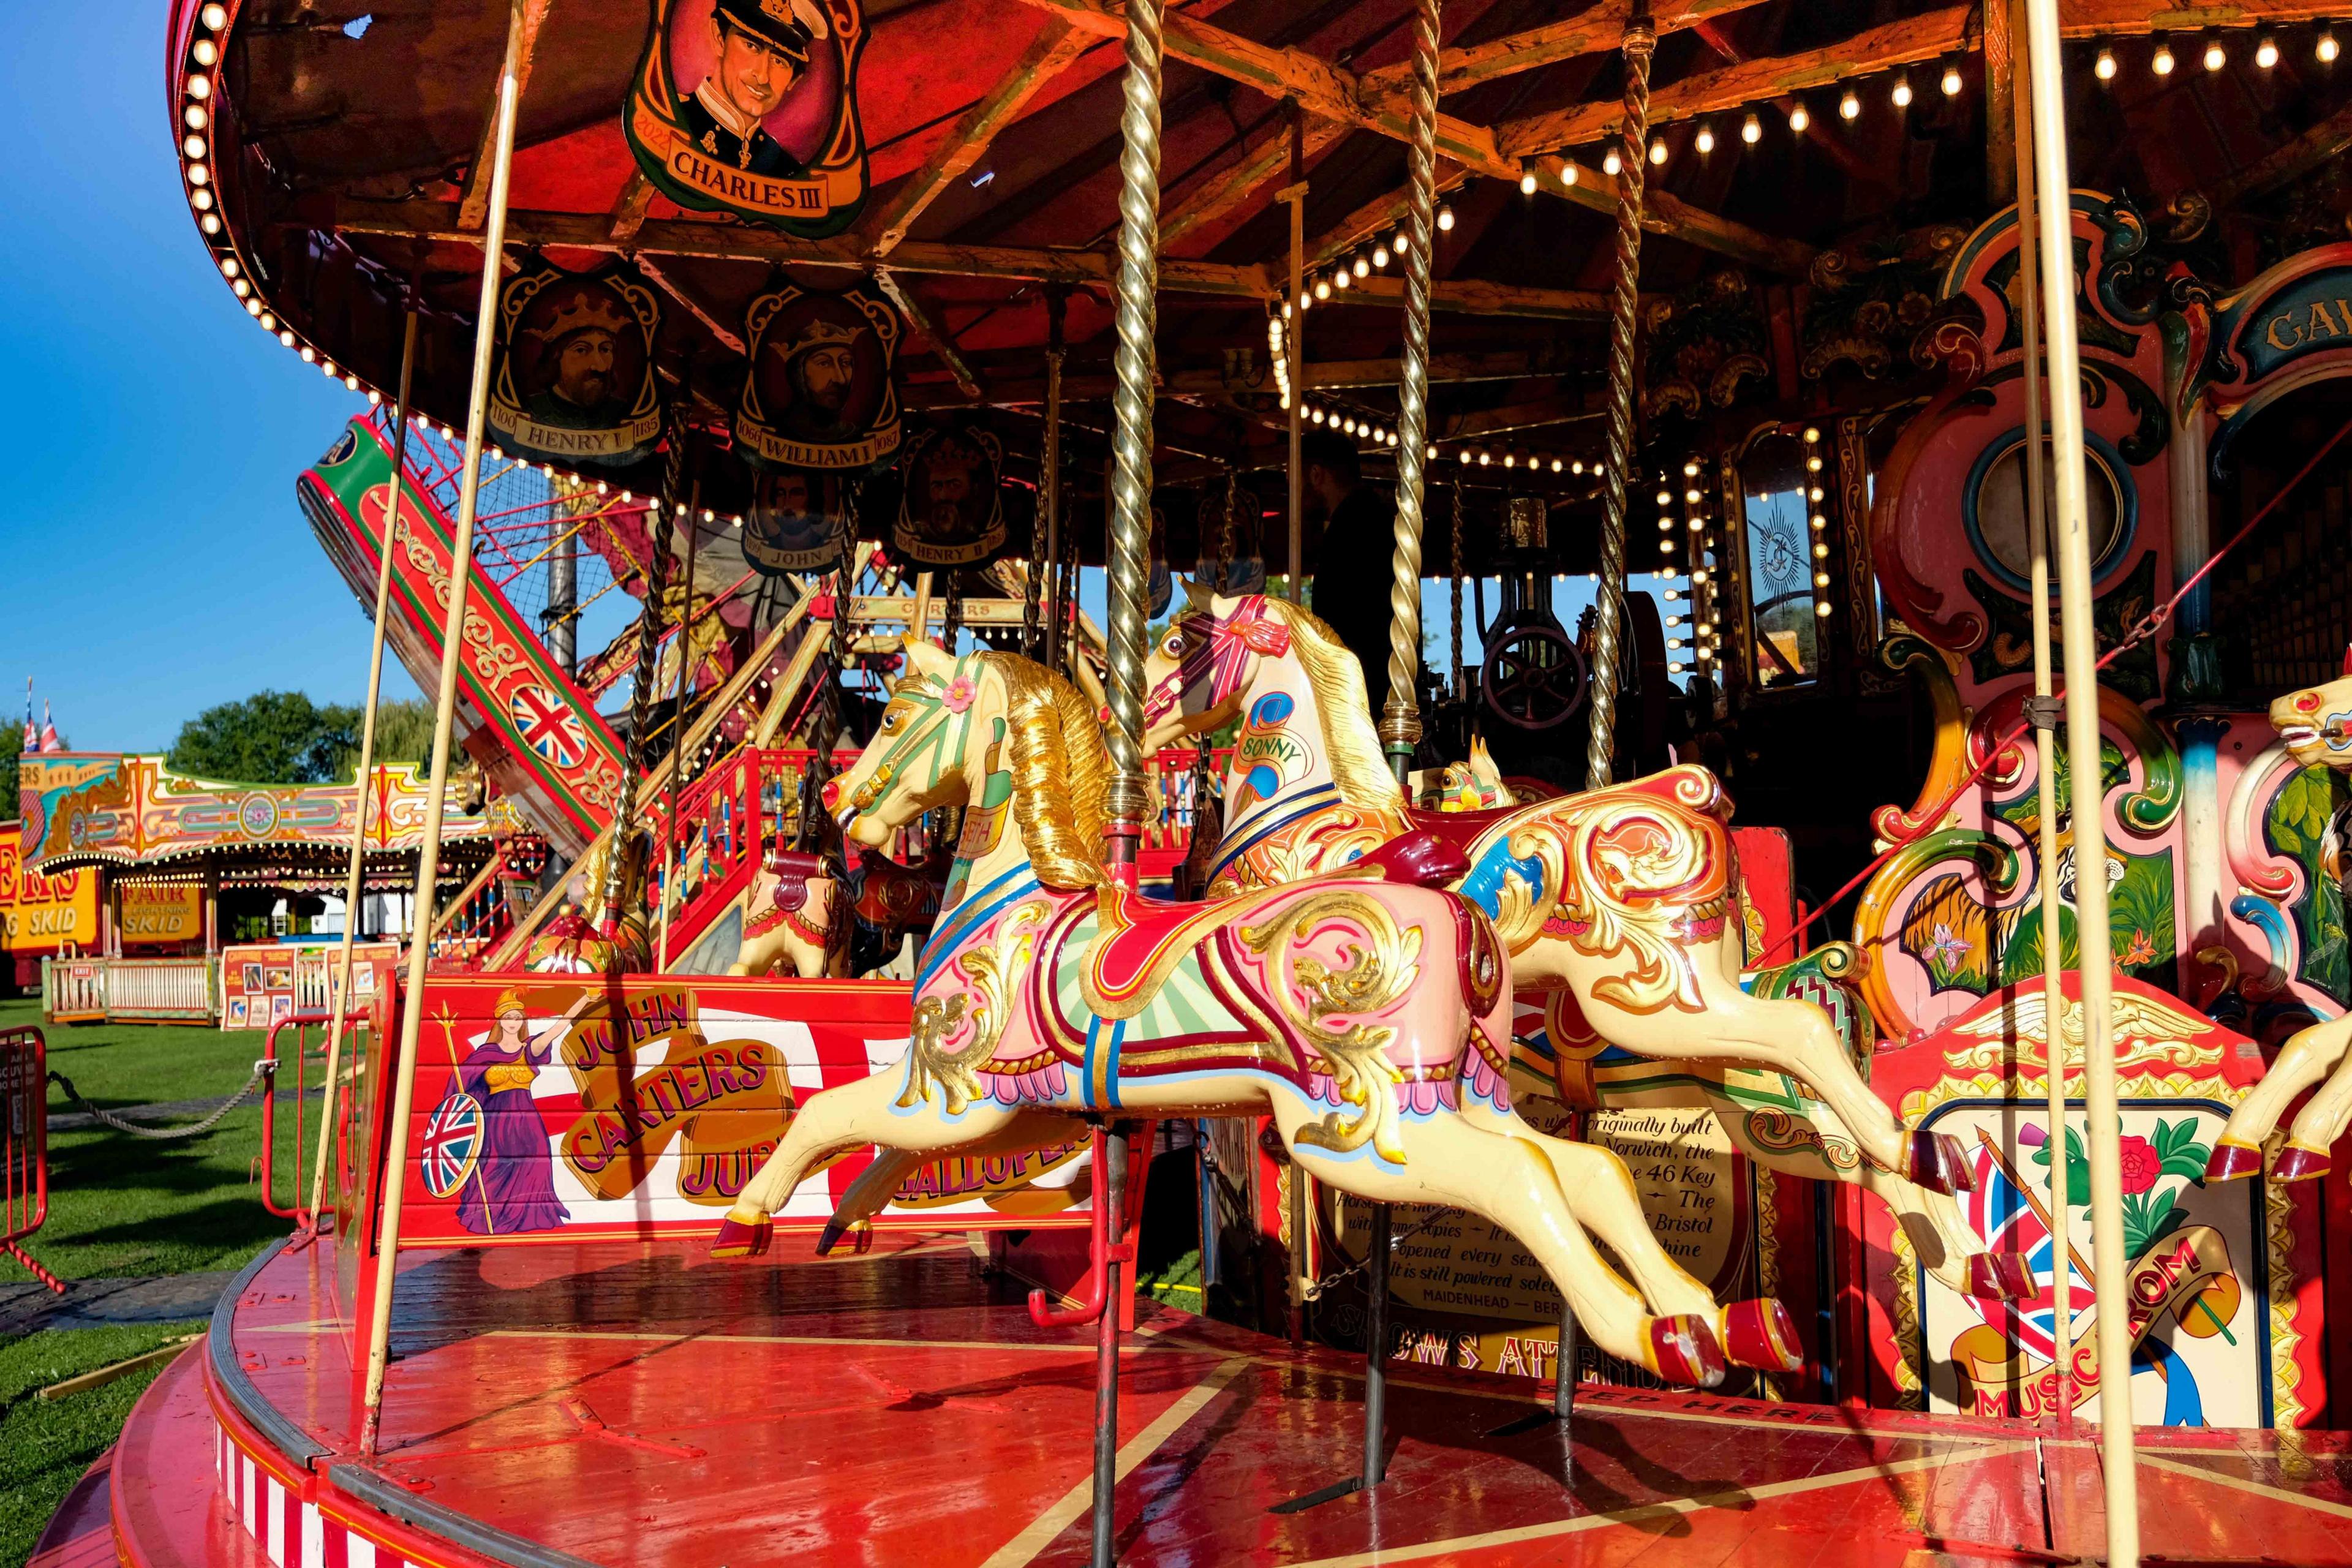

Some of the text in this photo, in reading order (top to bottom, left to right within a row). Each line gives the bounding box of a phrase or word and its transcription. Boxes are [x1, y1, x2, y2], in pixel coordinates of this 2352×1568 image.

[635, 114, 669, 151] 2022
[674, 151, 822, 209] CHARLES III
[492, 404, 515, 429] 1100
[635, 418, 658, 438] 1135
[527, 427, 624, 451] HENRY I
[737, 420, 761, 443] 1066
[876, 434, 897, 452] 1087
[765, 437, 871, 466] WILLIAM I
[771, 550, 822, 565] JOHN
[917, 545, 965, 560] HENRY
[902, 603, 990, 616] CRRS
[1243, 737, 1302, 763] SONNY
[30, 907, 77, 936] SKID
[125, 914, 183, 934] SKID
[576, 991, 688, 1072] JOHN
[570, 1043, 767, 1174] CARTERS
[1591, 1116, 1665, 1136] originally
[1670, 1117, 1714, 1136] built
[1601, 1137, 1679, 1160] Norwich,
[1685, 1142, 1716, 1161] the
[1646, 1164, 1675, 1182] 46
[1679, 1166, 1716, 1188] Key
[1679, 1189, 1715, 1210] The
[1420, 1221, 1462, 1238] copies
[1488, 1225, 1501, 1240] It
[1654, 1215, 1714, 1234] Bristol
[1398, 1245, 1451, 1259] opened
[1461, 1248, 1502, 1267] every
[1390, 1261, 1563, 1297] It is still powered solely
[1423, 1289, 1509, 1308] MAIDENHEAD
[1330, 1303, 1483, 1370] SOWS
[1974, 1236, 2203, 1420] MUSIC ROM
[1682, 1400, 1844, 1422] HERE
